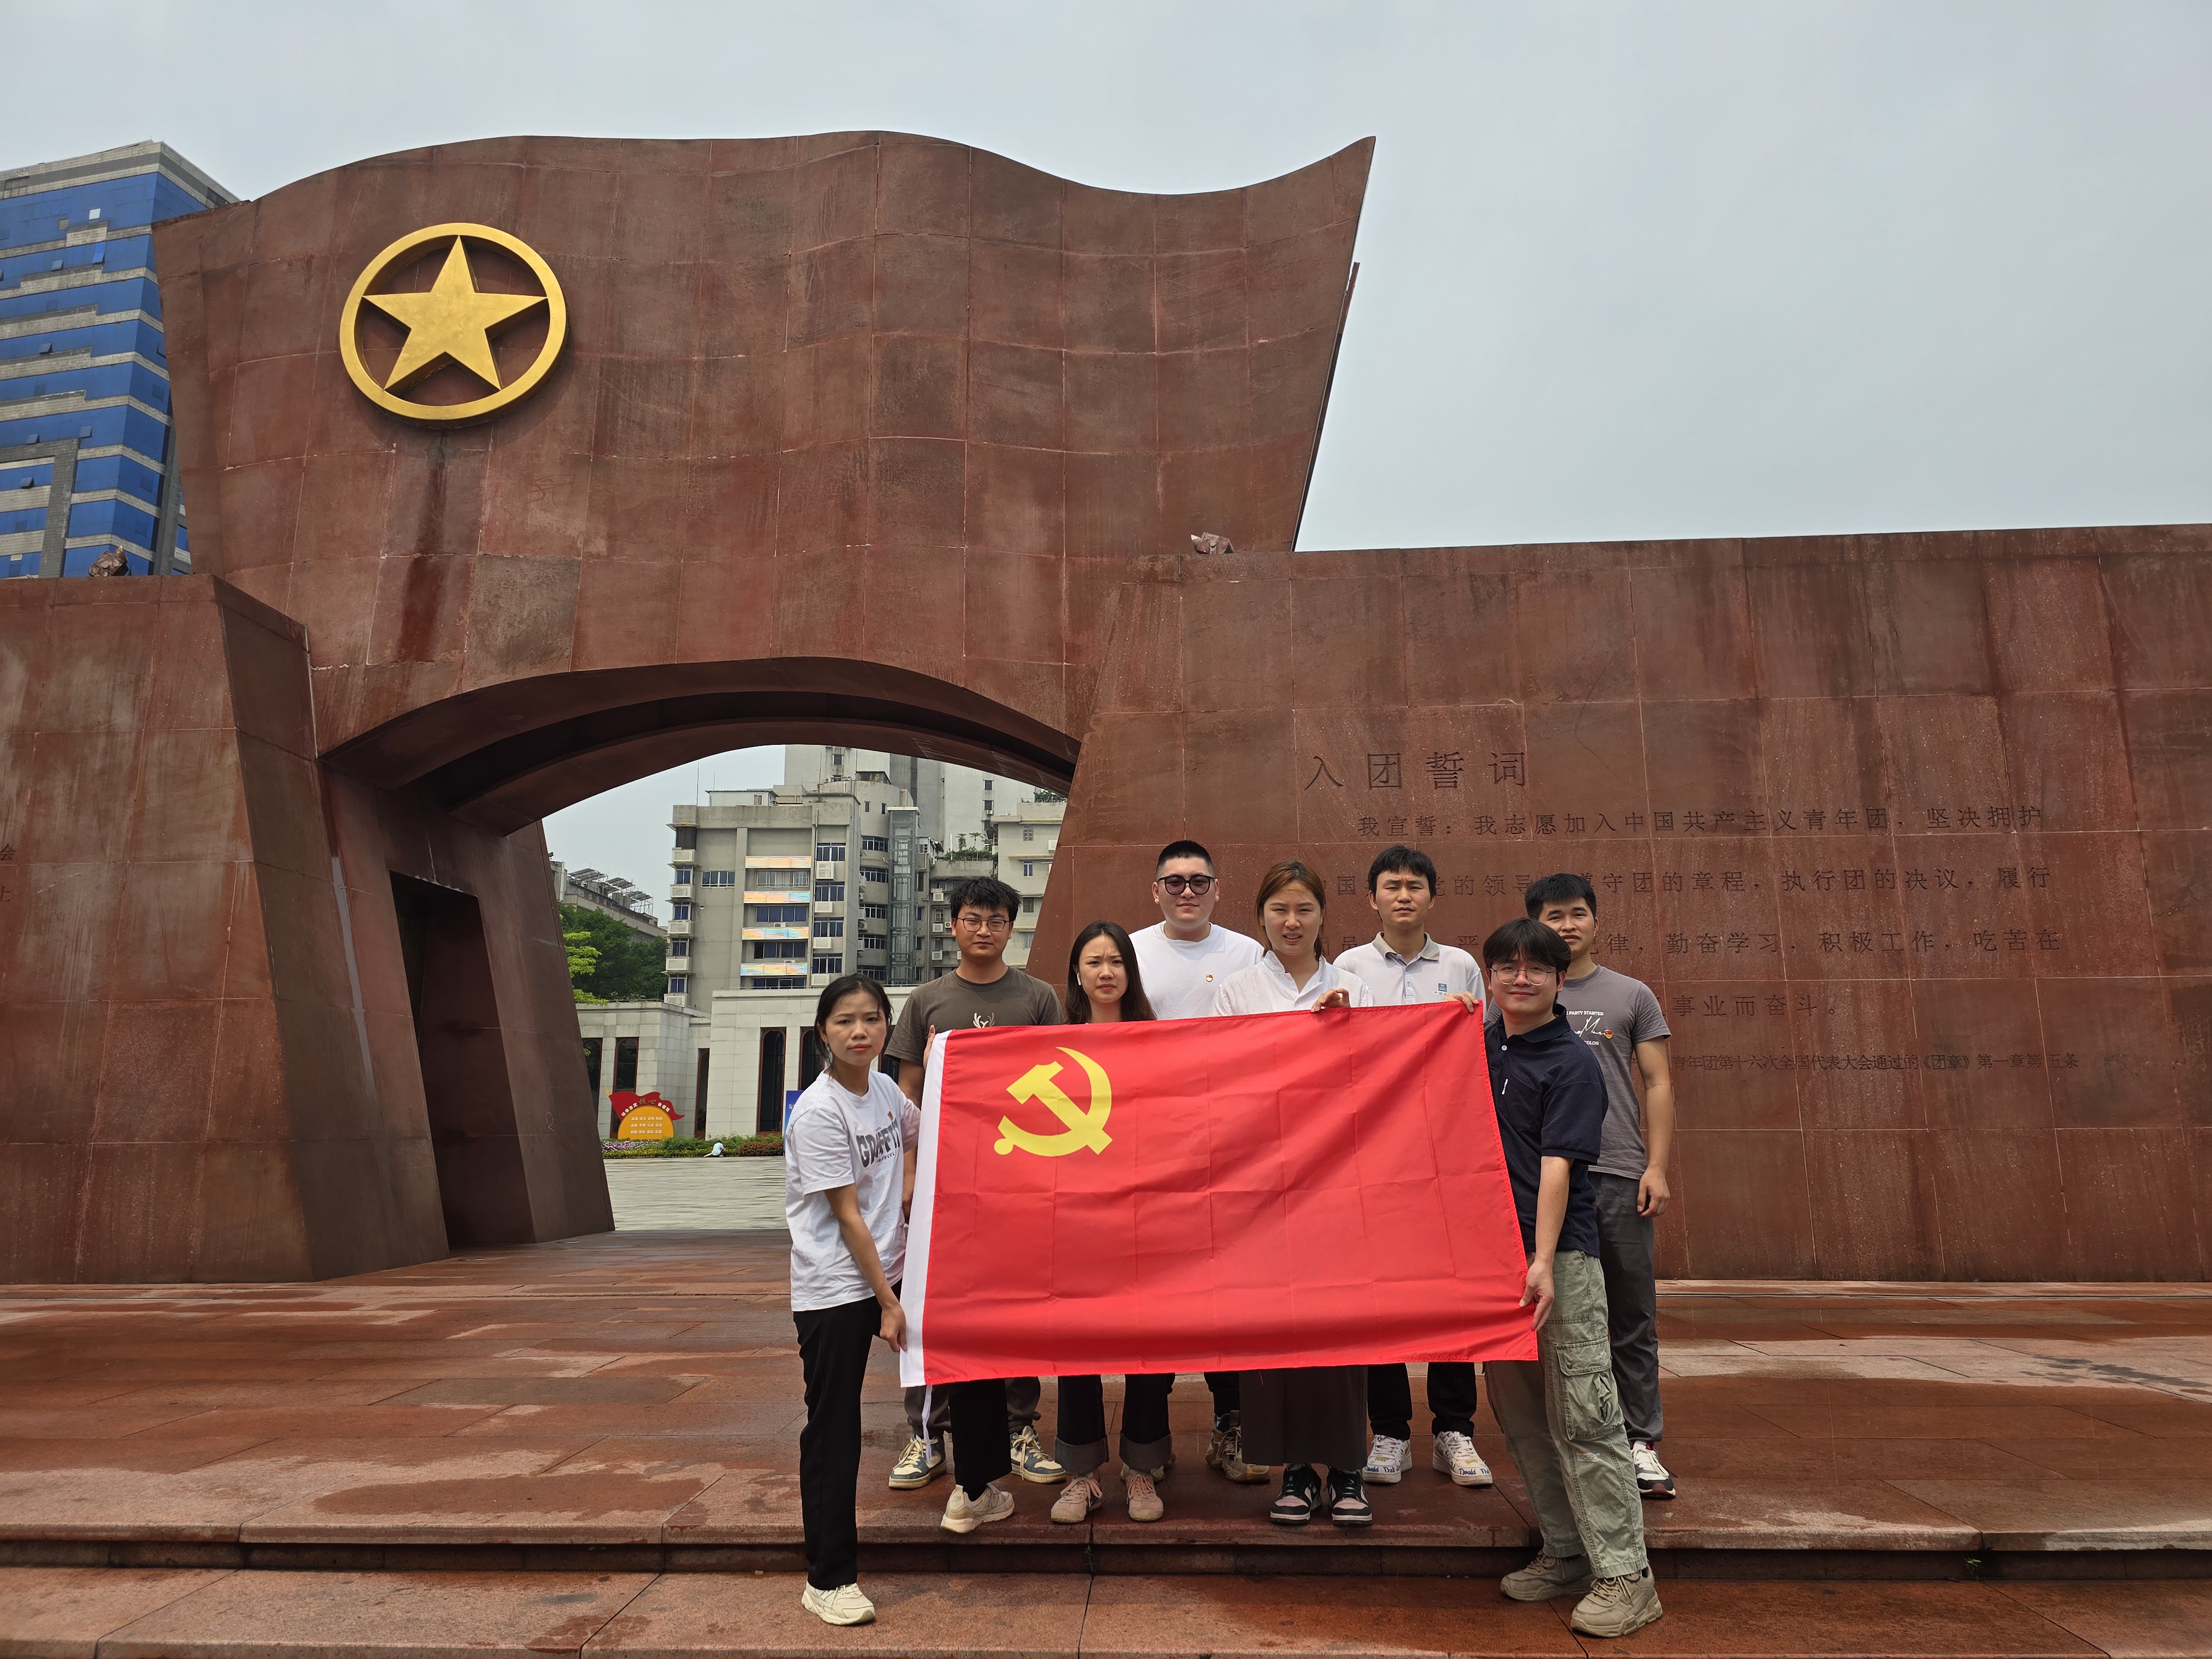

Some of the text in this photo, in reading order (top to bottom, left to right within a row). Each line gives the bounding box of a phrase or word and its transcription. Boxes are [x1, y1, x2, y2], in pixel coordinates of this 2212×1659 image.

[1304, 751, 1526, 791] 入团誓词
[1657, 994, 1835, 1018] 事业而奋斗。
[1668, 1052, 2080, 1071] 青年团第十六次全国代表大会通过的《团章》第一章第五条
